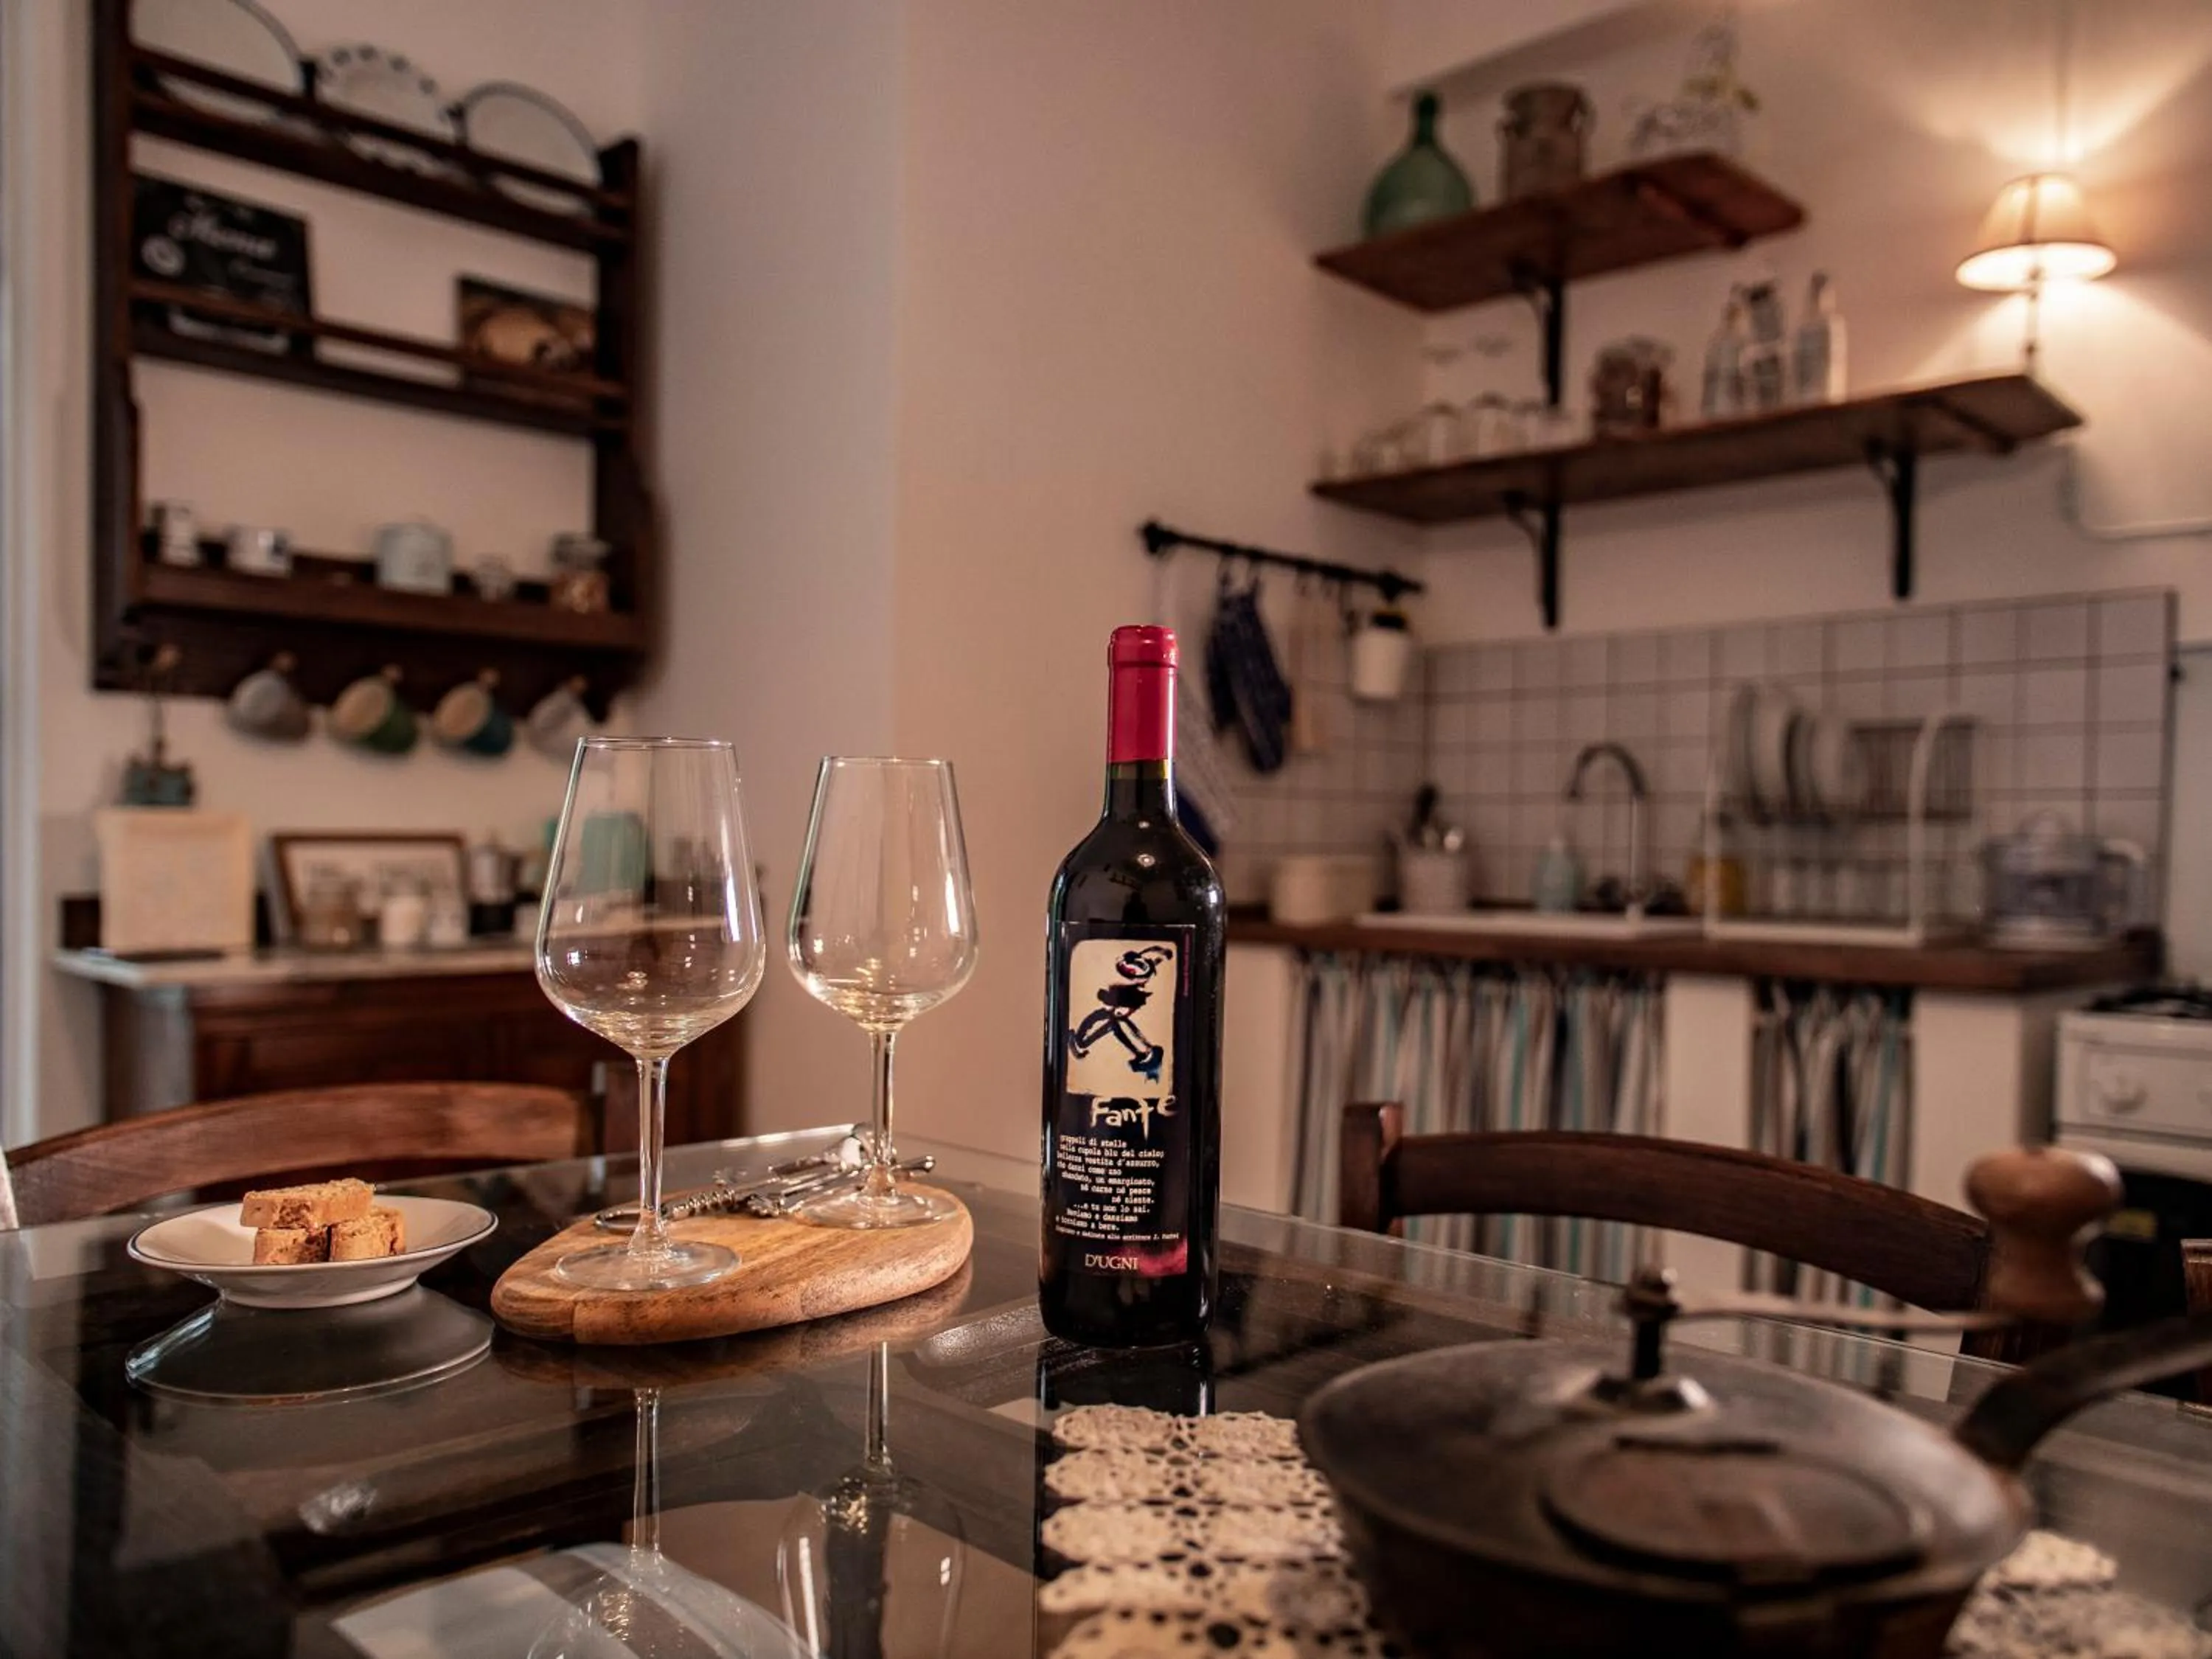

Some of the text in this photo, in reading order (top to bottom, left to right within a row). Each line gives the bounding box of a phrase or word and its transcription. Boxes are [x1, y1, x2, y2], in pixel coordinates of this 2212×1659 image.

[1091, 1095, 1179, 1141] Fante
[1088, 1138, 1097, 1146] di
[1121, 1149, 1135, 1158] del
[1120, 1205, 1130, 1213] lo
[1085, 1253, 1138, 1270] D'UGNI
